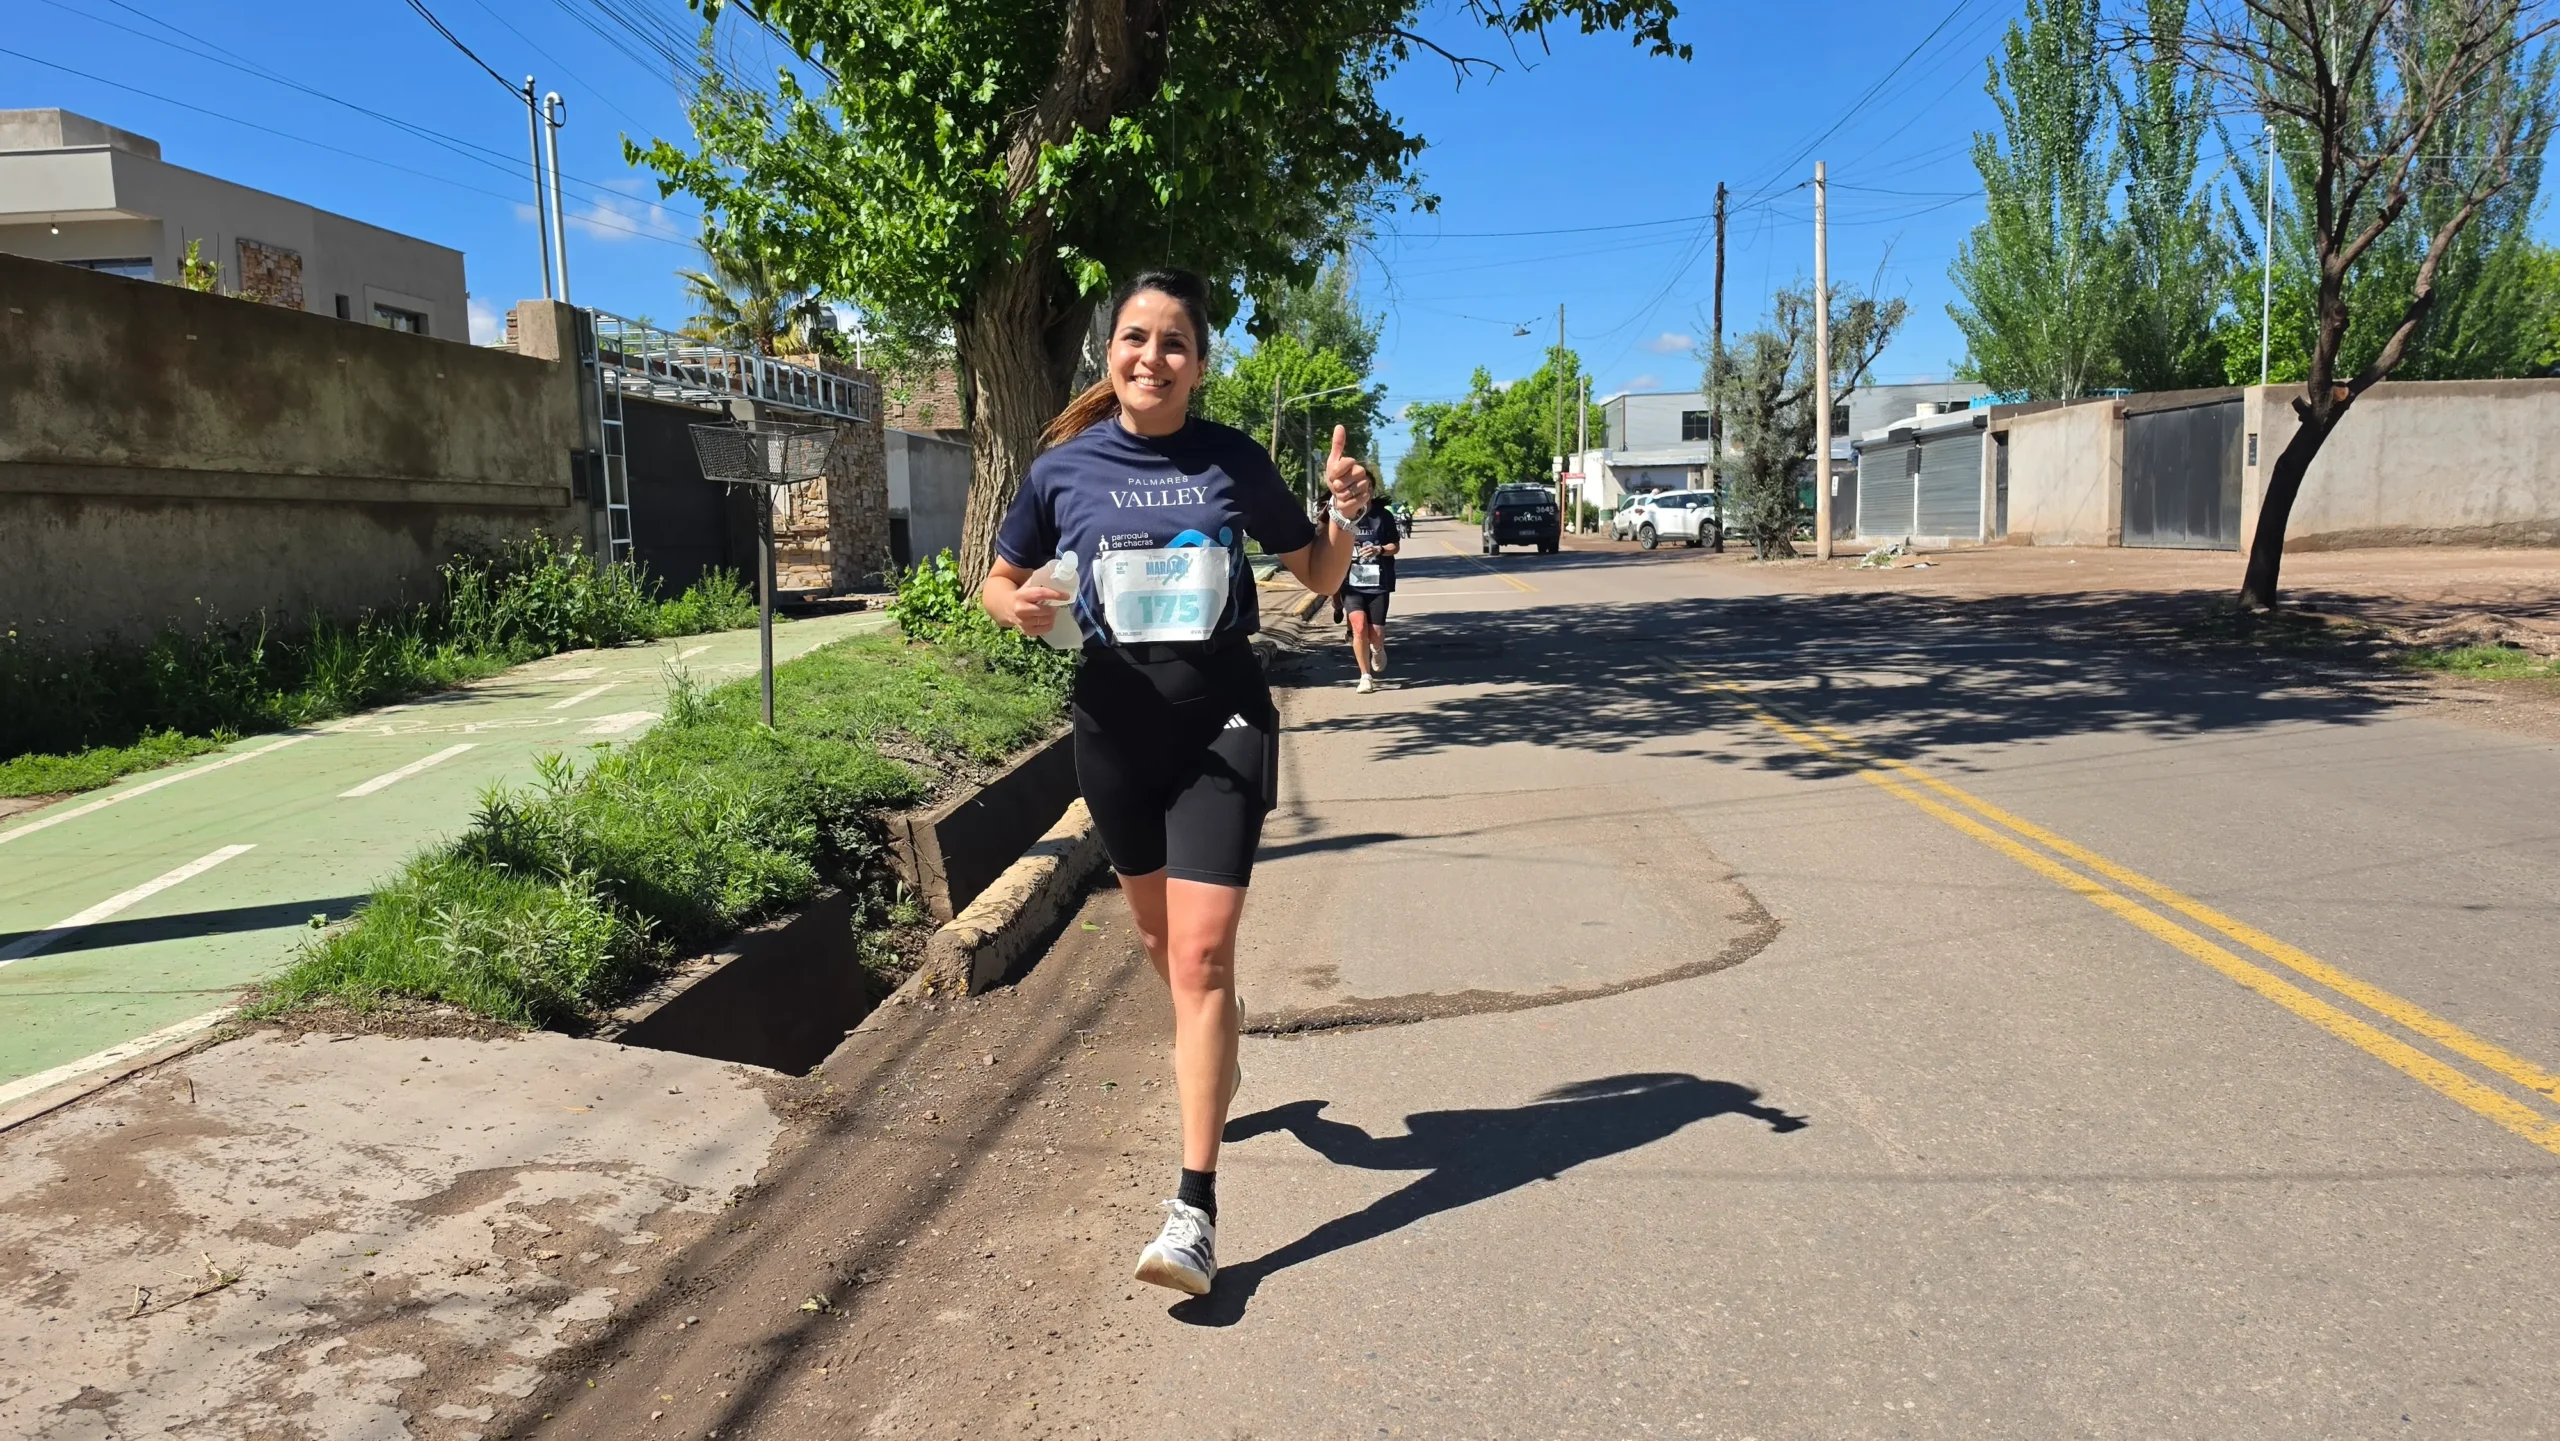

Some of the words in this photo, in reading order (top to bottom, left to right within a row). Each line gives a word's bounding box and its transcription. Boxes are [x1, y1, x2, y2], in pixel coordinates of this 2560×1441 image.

[1128, 475, 1189, 486] PALMARES
[1109, 486, 1208, 508] VALLEY
[1111, 532, 1149, 542] parroquia
[1124, 540, 1154, 548] chacras
[1138, 594, 1200, 624] 175
